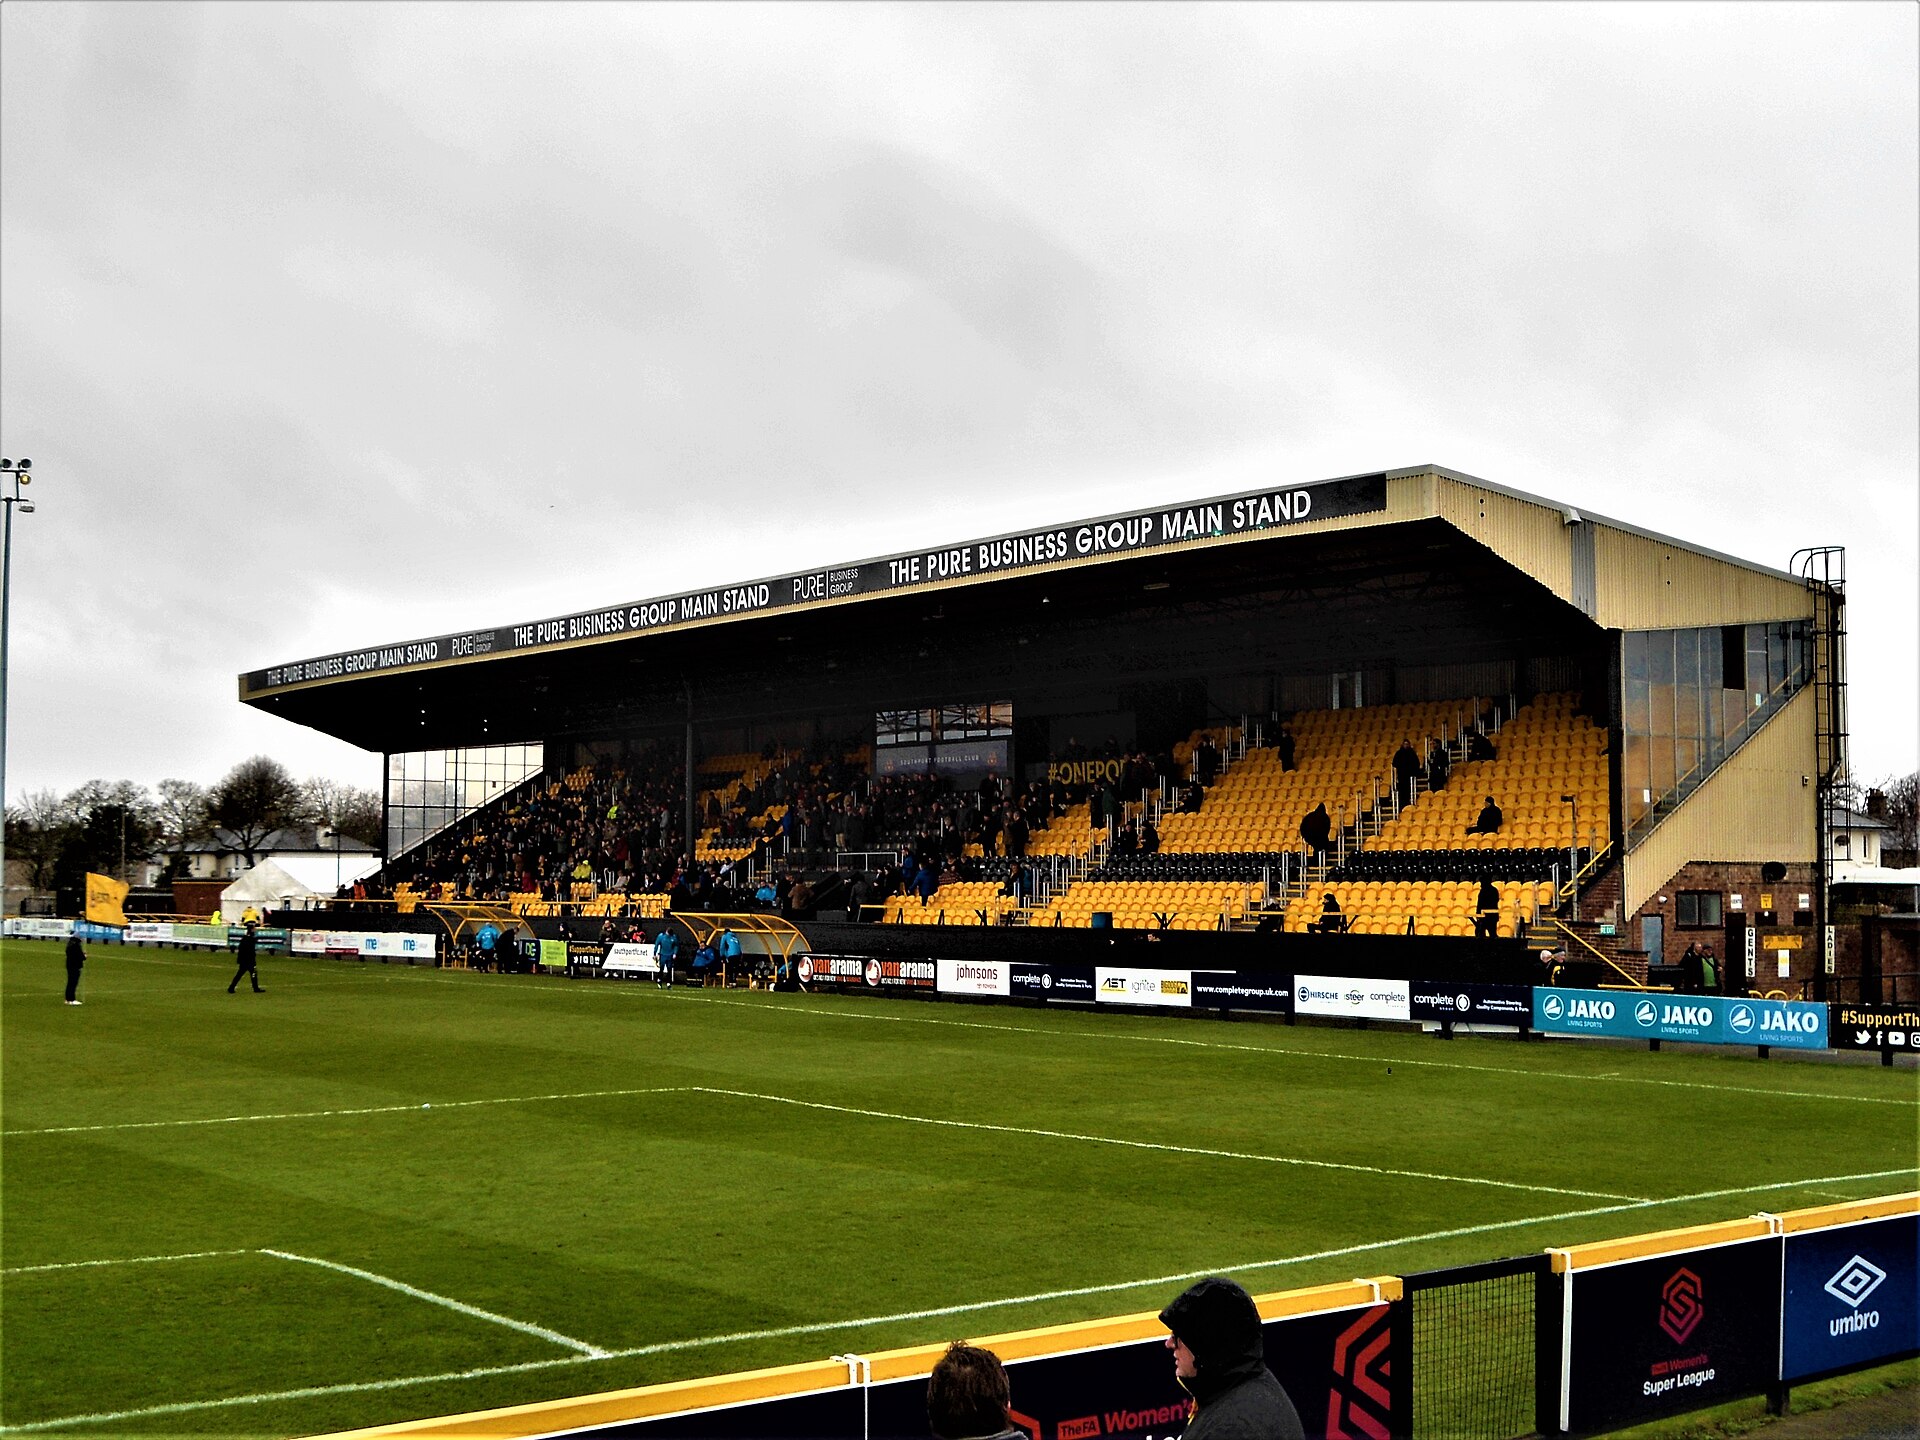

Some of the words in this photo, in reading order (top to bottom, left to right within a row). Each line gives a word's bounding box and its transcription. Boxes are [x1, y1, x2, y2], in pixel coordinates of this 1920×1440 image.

[889, 557, 920, 584] THE
[927, 547, 971, 578] PURE
[979, 531, 1067, 569] BUSINESS
[1075, 517, 1153, 553] GROUP
[1162, 504, 1223, 540] MAIN
[1232, 490, 1311, 528] STAND
[830, 568, 858, 582] BUSINESS
[793, 574, 824, 600] PURE
[830, 581, 854, 594] GROUP
[513, 625, 533, 646] THE
[537, 620, 565, 643] PURE
[569, 609, 624, 638] BUSINESS
[629, 600, 676, 628] GROUP
[681, 592, 718, 619] MAIN
[723, 584, 770, 612] STAND
[452, 635, 473, 656] PURE
[267, 669, 281, 686] THE
[283, 665, 303, 683] PURE
[305, 657, 343, 679] BUSINESS
[345, 651, 377, 673] GROUP
[379, 647, 404, 667] MAIN
[407, 641, 438, 663] STAND
[365, 938, 378, 950] me
[403, 939, 416, 951] me
[813, 959, 863, 976] vanarama
[881, 961, 935, 979] vanarama
[956, 964, 998, 981] johnsons
[1012, 973, 1041, 985] complete
[1131, 979, 1156, 993] ignite
[1196, 985, 1289, 998] www.completegroup.uk.com
[1310, 991, 1339, 1000] HIRSCHE
[1370, 992, 1406, 1004] complete
[1413, 993, 1454, 1007] complete
[1567, 999, 1615, 1020] JAKO
[1661, 1005, 1713, 1027] JAKO
[1760, 1010, 1819, 1033] JAKO
[1661, 1026, 1678, 1034] LIVING
[1678, 1027, 1699, 1035] SPORTS
[1760, 1034, 1779, 1042] LIVING
[1780, 1035, 1804, 1043] SPORTS
[1829, 1309, 1880, 1337] umbro
[1643, 1377, 1676, 1396] Super
[1677, 1368, 1716, 1387] League
